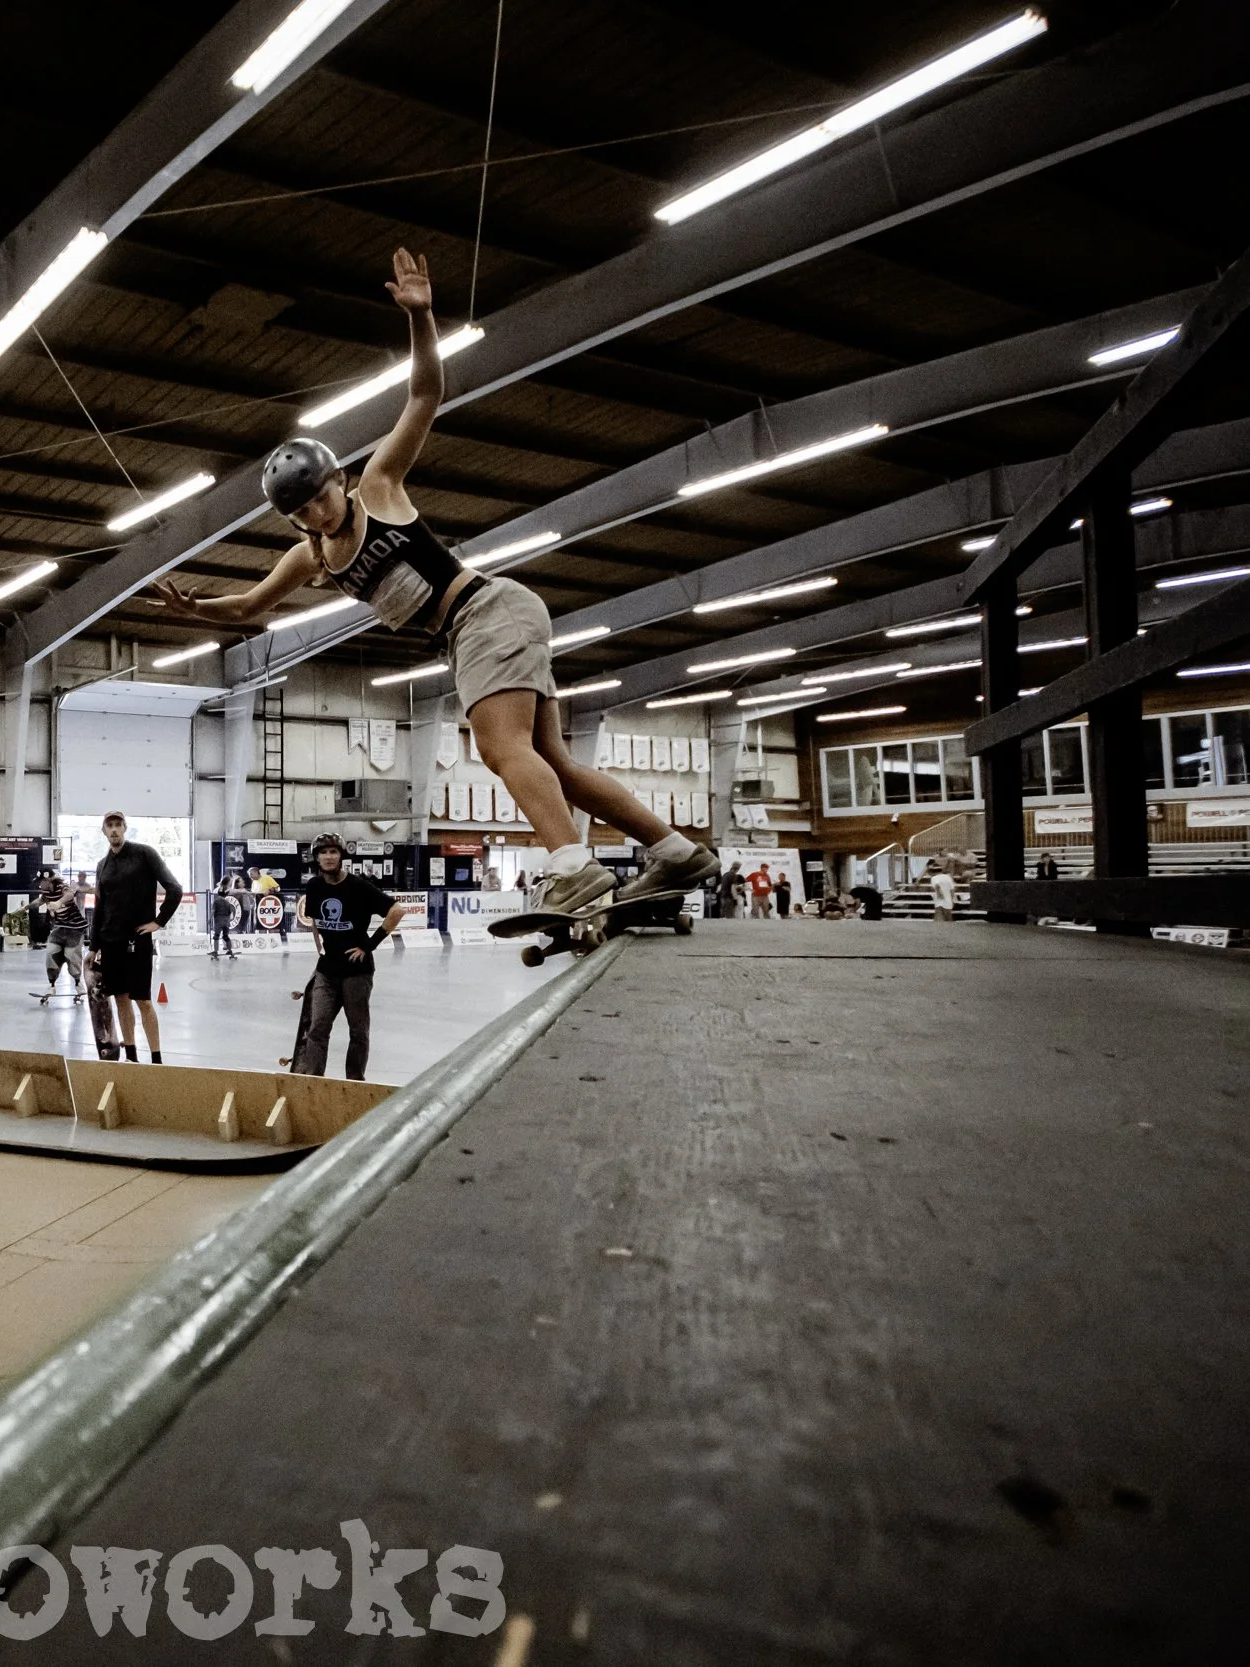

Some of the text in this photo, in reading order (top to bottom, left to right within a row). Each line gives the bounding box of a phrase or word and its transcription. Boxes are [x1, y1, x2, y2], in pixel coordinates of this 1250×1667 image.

[342, 528, 411, 595] ANADA
[259, 906, 280, 915] BONES
[451, 897, 481, 914] NU
[318, 920, 350, 930] SKATES
